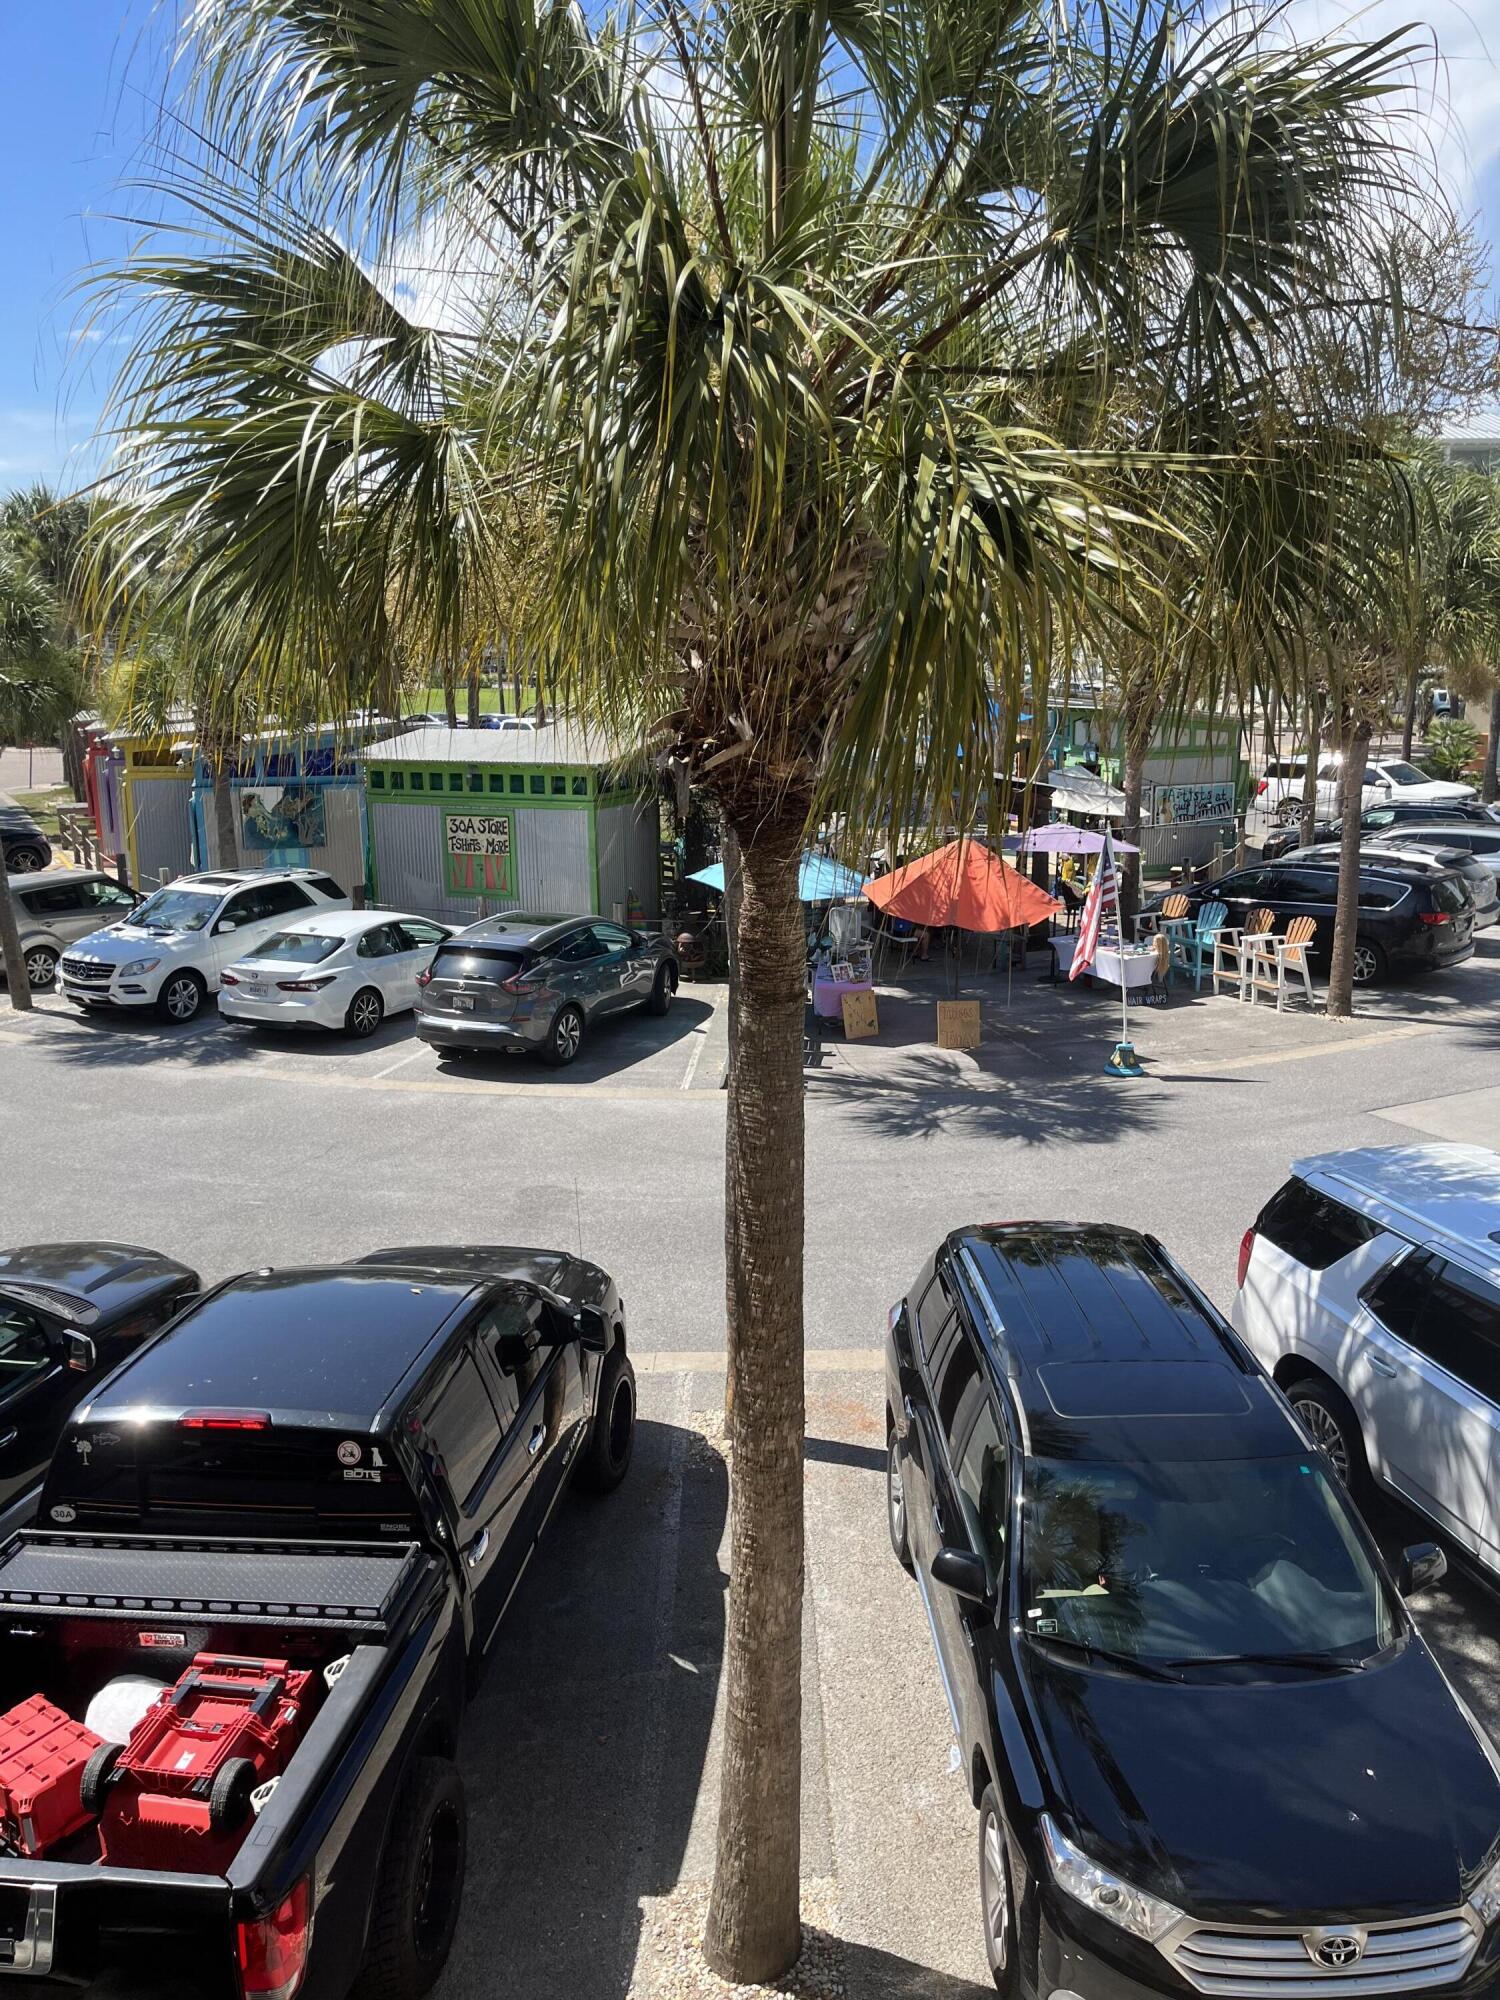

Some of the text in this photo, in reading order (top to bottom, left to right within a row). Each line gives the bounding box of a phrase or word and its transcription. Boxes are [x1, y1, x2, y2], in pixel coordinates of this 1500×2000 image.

[1168, 786, 1212, 802] Artists
[1215, 788, 1227, 801] at
[450, 817, 507, 835] 30A STORE
[485, 838, 509, 854] MORE
[1127, 995, 1167, 1005] HAIR WRAPS
[54, 1510, 73, 1518] 30A
